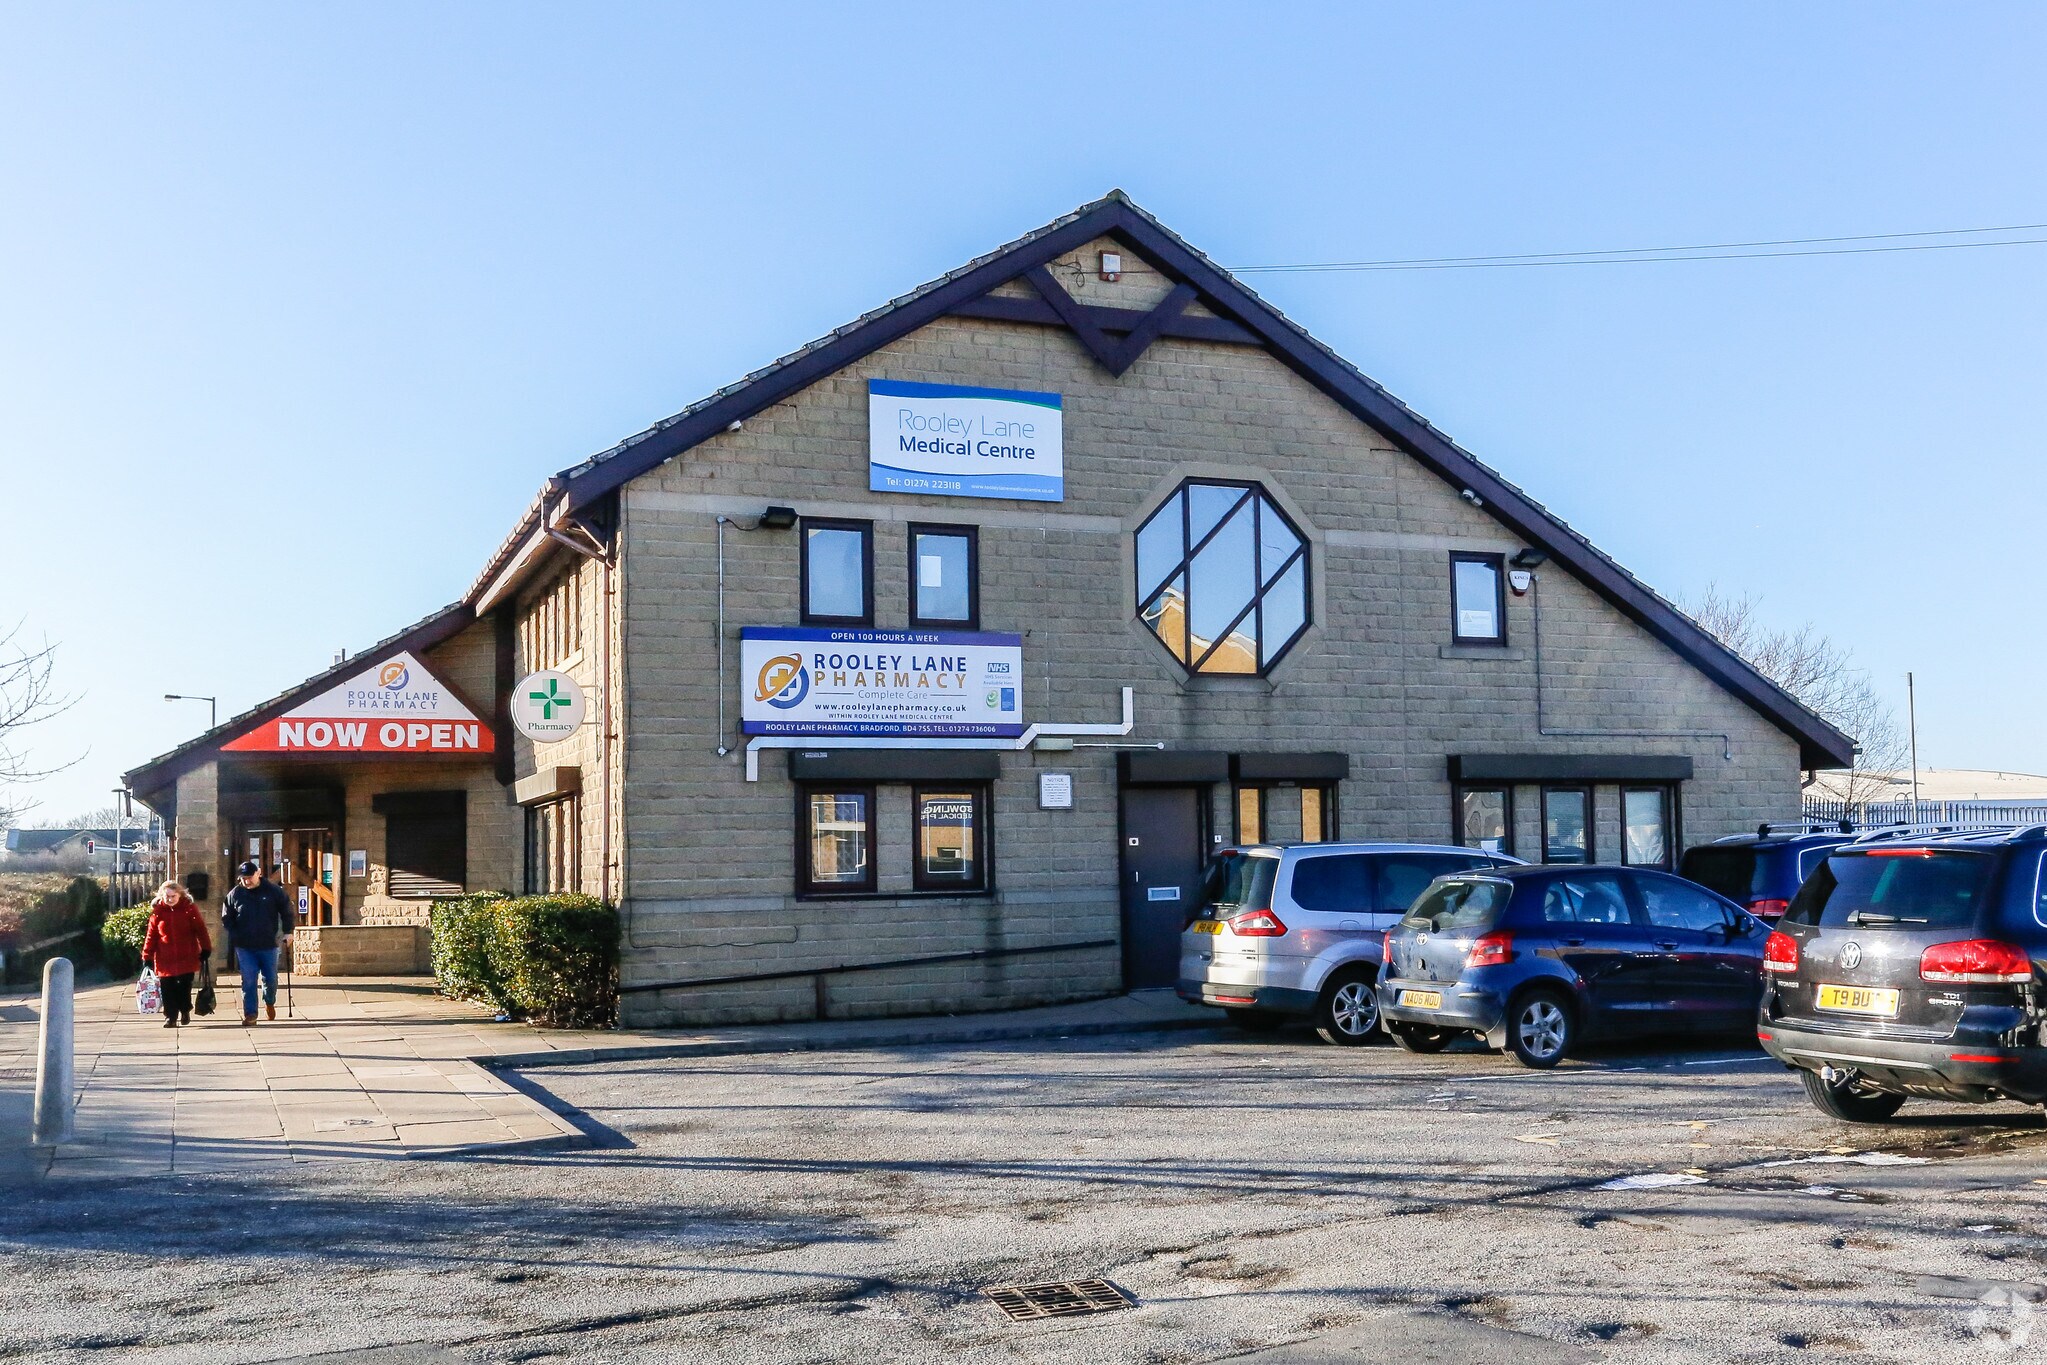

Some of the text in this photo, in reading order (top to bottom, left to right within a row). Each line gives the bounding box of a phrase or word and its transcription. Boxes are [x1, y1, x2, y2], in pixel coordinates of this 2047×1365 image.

[899, 409, 1035, 439] Rooley Lane
[900, 435, 1035, 460] Medical Centre
[885, 477, 962, 490] Tel: 01274 223118
[831, 632, 940, 642] OPEN 100 HOURS A WEEK
[814, 653, 967, 672] ROOLEY LANE
[988, 663, 1009, 672] NHS
[814, 670, 967, 689] PHARMACY
[347, 690, 438, 702] ROOLEY LANE
[858, 690, 928, 700] Complete Care
[347, 700, 438, 710] PHARMACY
[814, 703, 967, 713] www.rooleylanepharmacy.co.uk
[527, 722, 574, 732] Pharmacy
[765, 723, 796, 731] ROOLEY
[817, 724, 859, 732] PHARMACY,
[934, 725, 949, 733] TEL:
[278, 721, 479, 749] NOW OPEN
[1833, 989, 1849, 1005] T9
[1928, 998, 1964, 1006] SPORT
